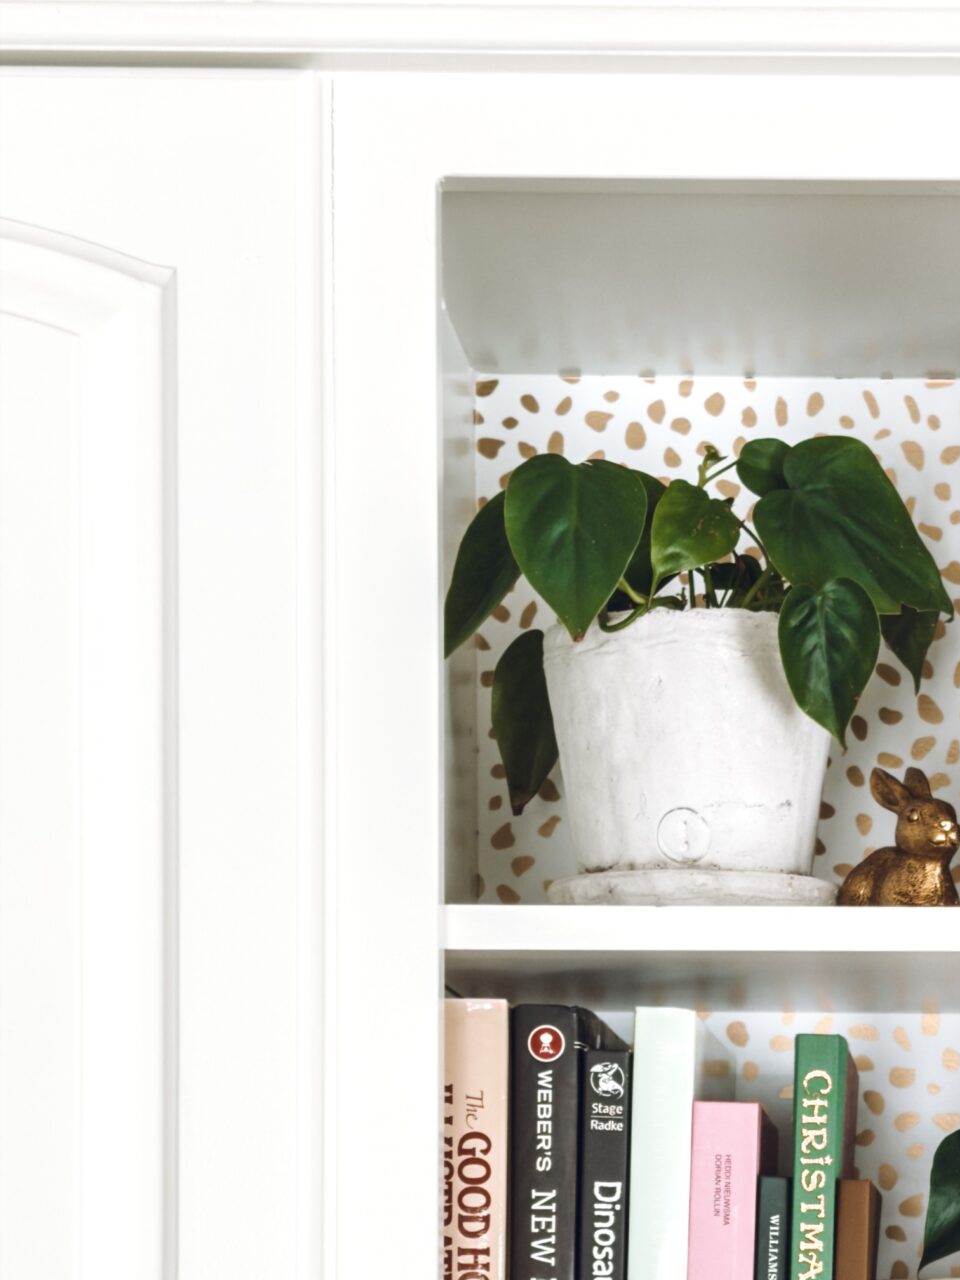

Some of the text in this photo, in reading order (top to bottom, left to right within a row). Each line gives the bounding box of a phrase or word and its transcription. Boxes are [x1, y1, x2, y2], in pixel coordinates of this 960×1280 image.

[464, 1089, 484, 1130] The
[535, 1069, 553, 1173] WEBER'S
[589, 1118, 624, 1132] Radke
[590, 1102, 624, 1117] Stage
[457, 1130, 492, 1240] GOOD
[711, 1153, 722, 1217] DORIAN ROLLIN
[723, 1153, 732, 1180] HEDDI
[530, 1188, 557, 1268] NEW
